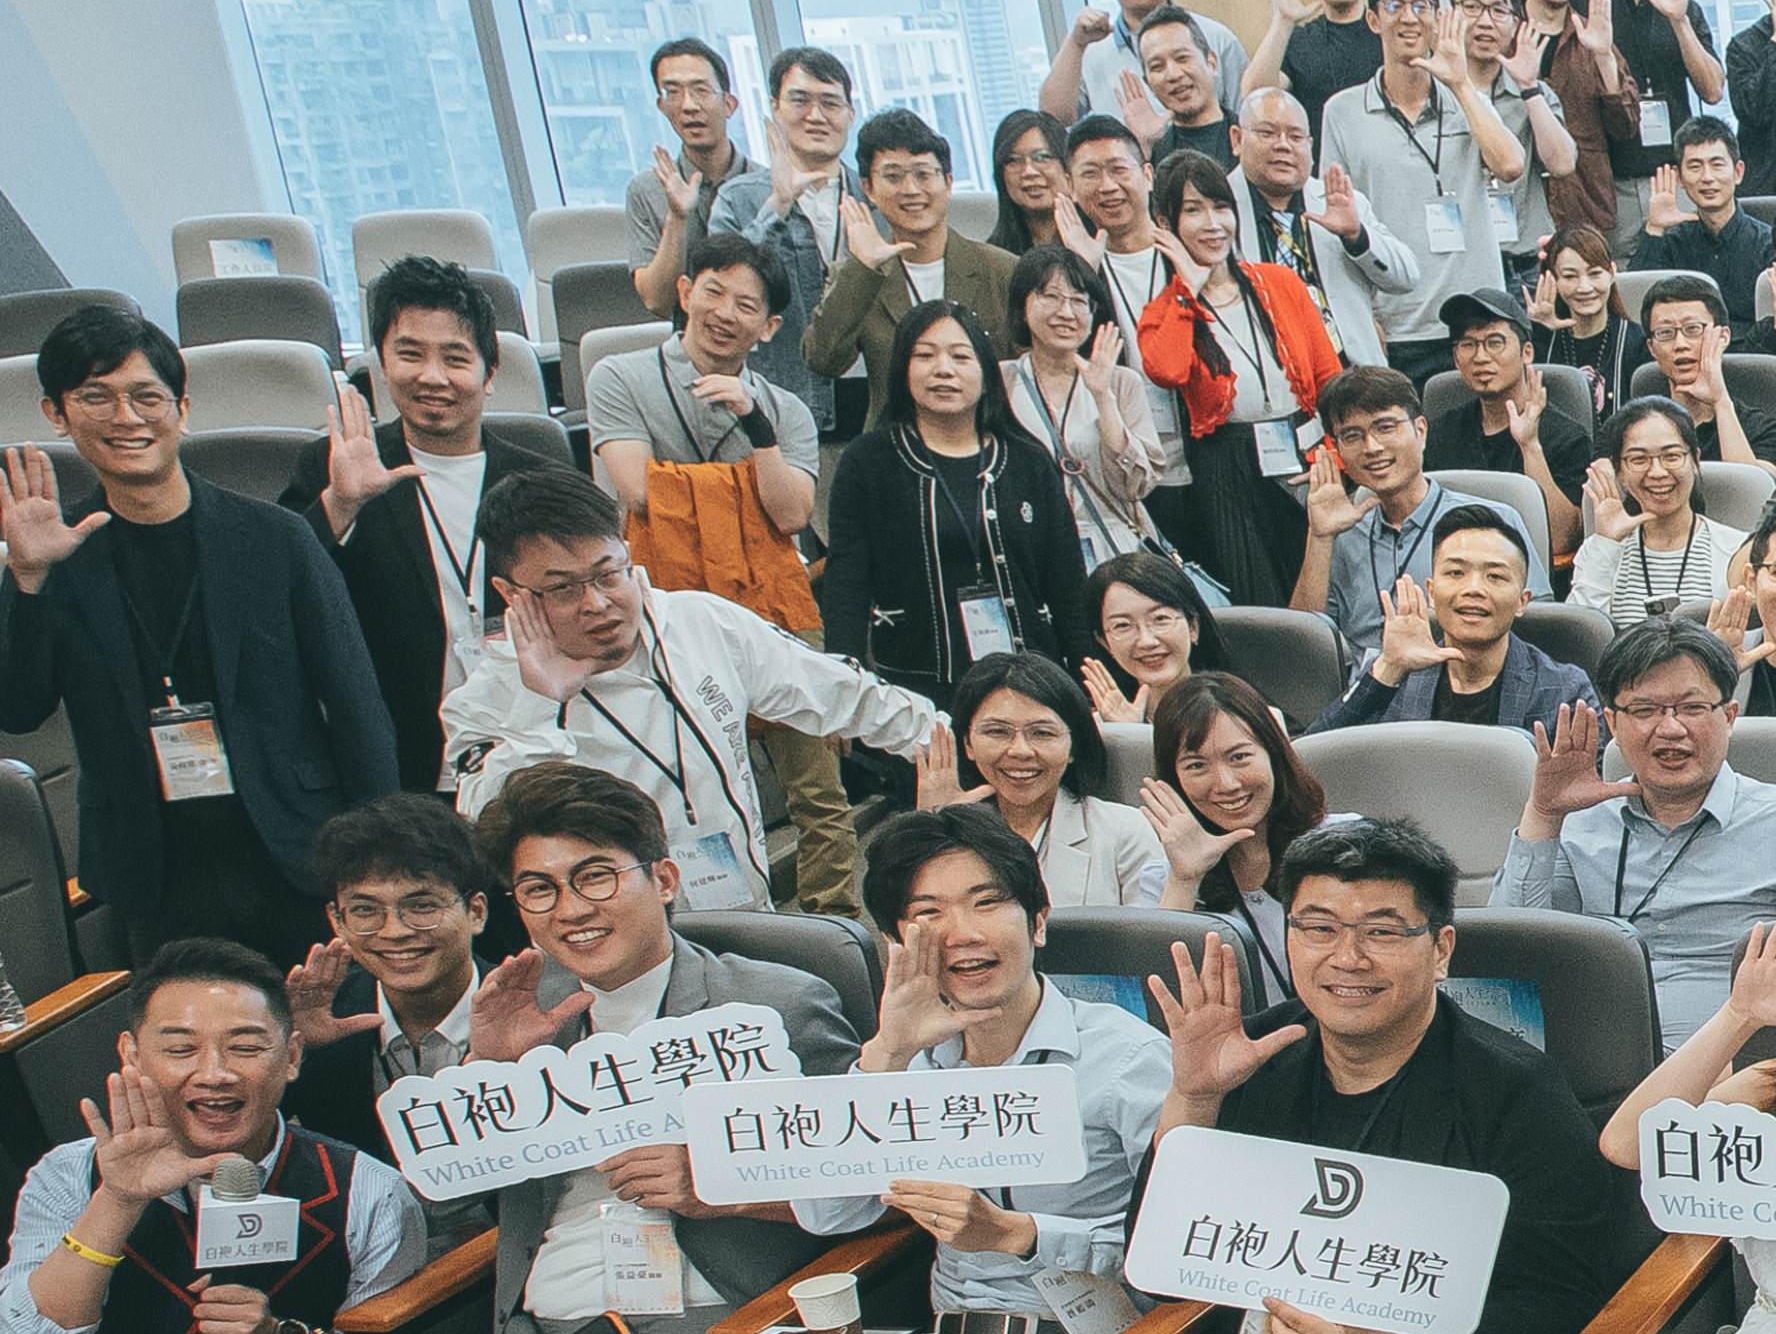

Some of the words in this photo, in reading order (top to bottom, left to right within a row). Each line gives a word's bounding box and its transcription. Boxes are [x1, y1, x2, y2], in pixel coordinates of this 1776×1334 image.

[695, 675, 733, 723] WE
[397, 1021, 784, 1156] 白袍人生學院
[422, 1150, 516, 1189] White
[521, 1132, 592, 1166] Coat
[594, 1118, 651, 1154] Life
[724, 1091, 1045, 1154] 白袍人生學院
[737, 1164, 811, 1183] White
[819, 1159, 876, 1177] Coat
[883, 1156, 929, 1173] Life
[935, 1150, 1046, 1171] Academy
[1658, 1193, 1745, 1221] White
[1182, 1215, 1449, 1299] 白袍人生學院
[1178, 1267, 1239, 1295] White
[1243, 1280, 1292, 1302] Coat
[1297, 1289, 1336, 1310] Life
[1340, 1296, 1437, 1329] Academy
